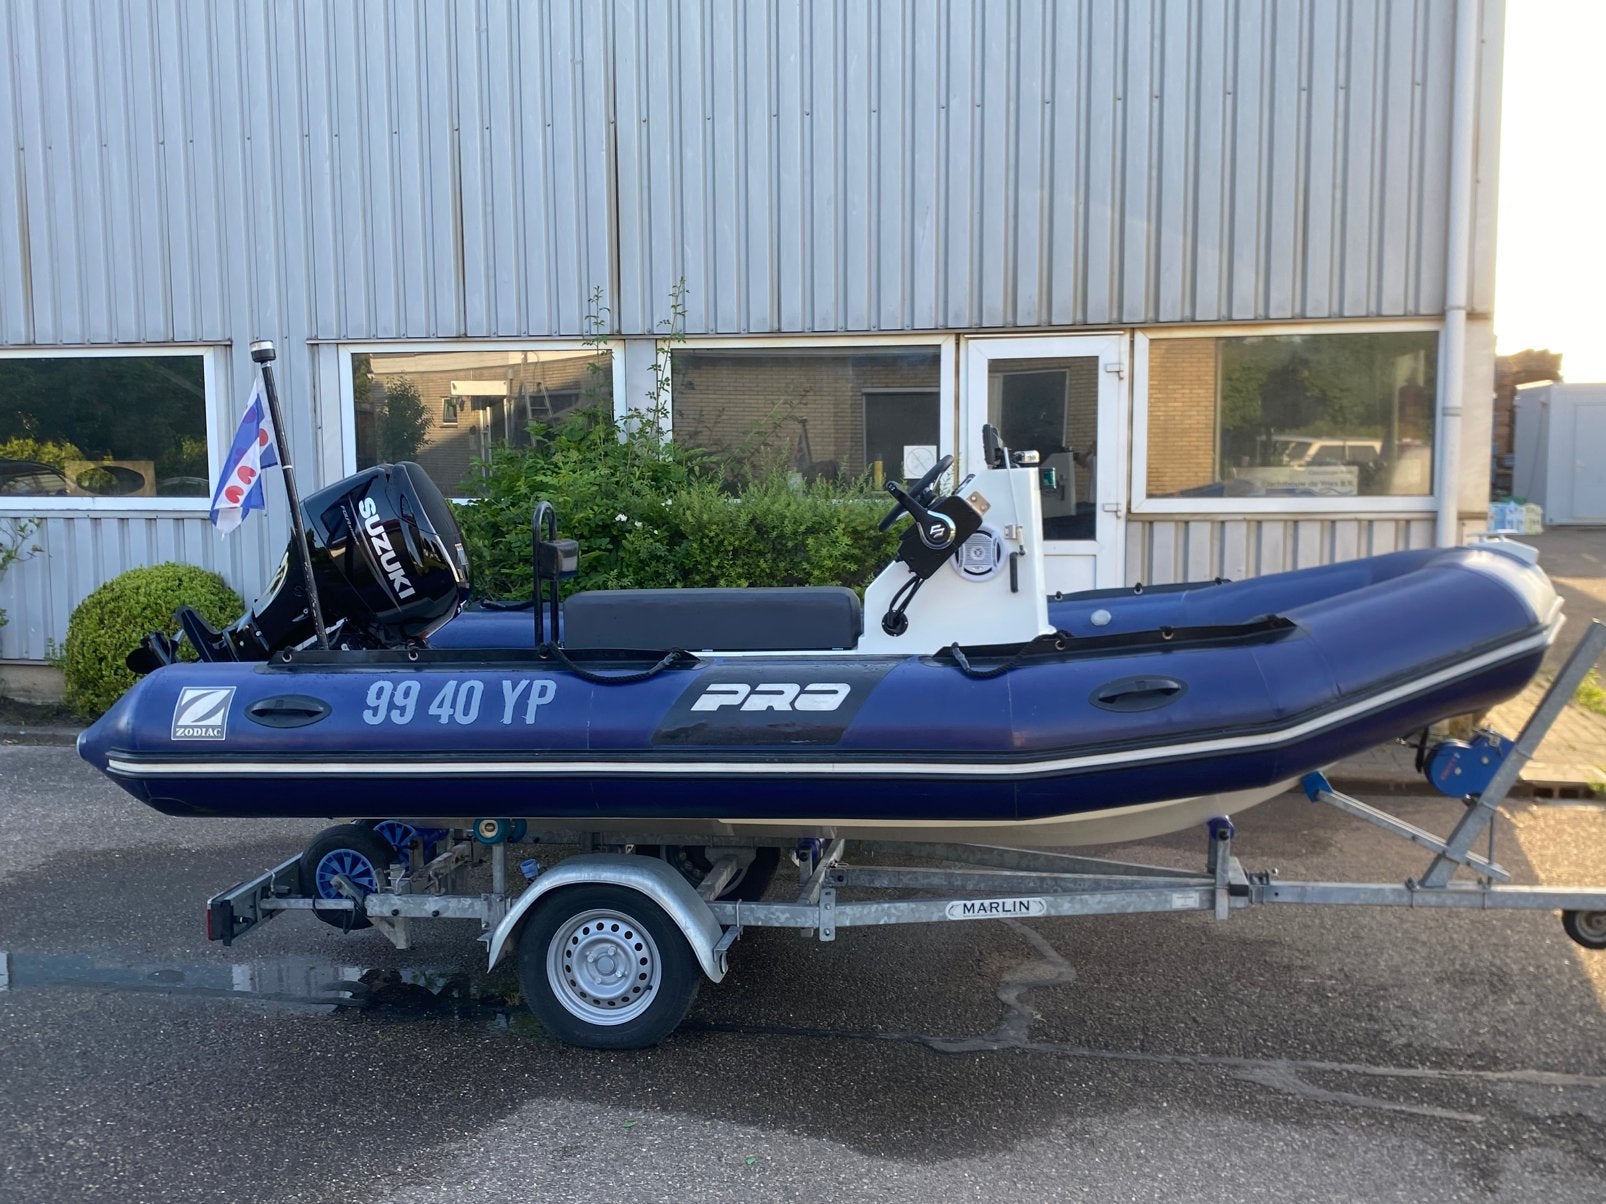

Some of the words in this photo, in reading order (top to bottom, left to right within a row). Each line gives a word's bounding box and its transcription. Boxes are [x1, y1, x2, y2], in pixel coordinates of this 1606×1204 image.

[358, 497, 416, 599] SUZUKI
[363, 680, 421, 725] 99
[428, 680, 484, 725] 40
[501, 679, 557, 725] YP
[690, 683, 851, 711] PRO
[175, 727, 222, 737] ZODIAC
[963, 900, 1030, 914] MARLIN
